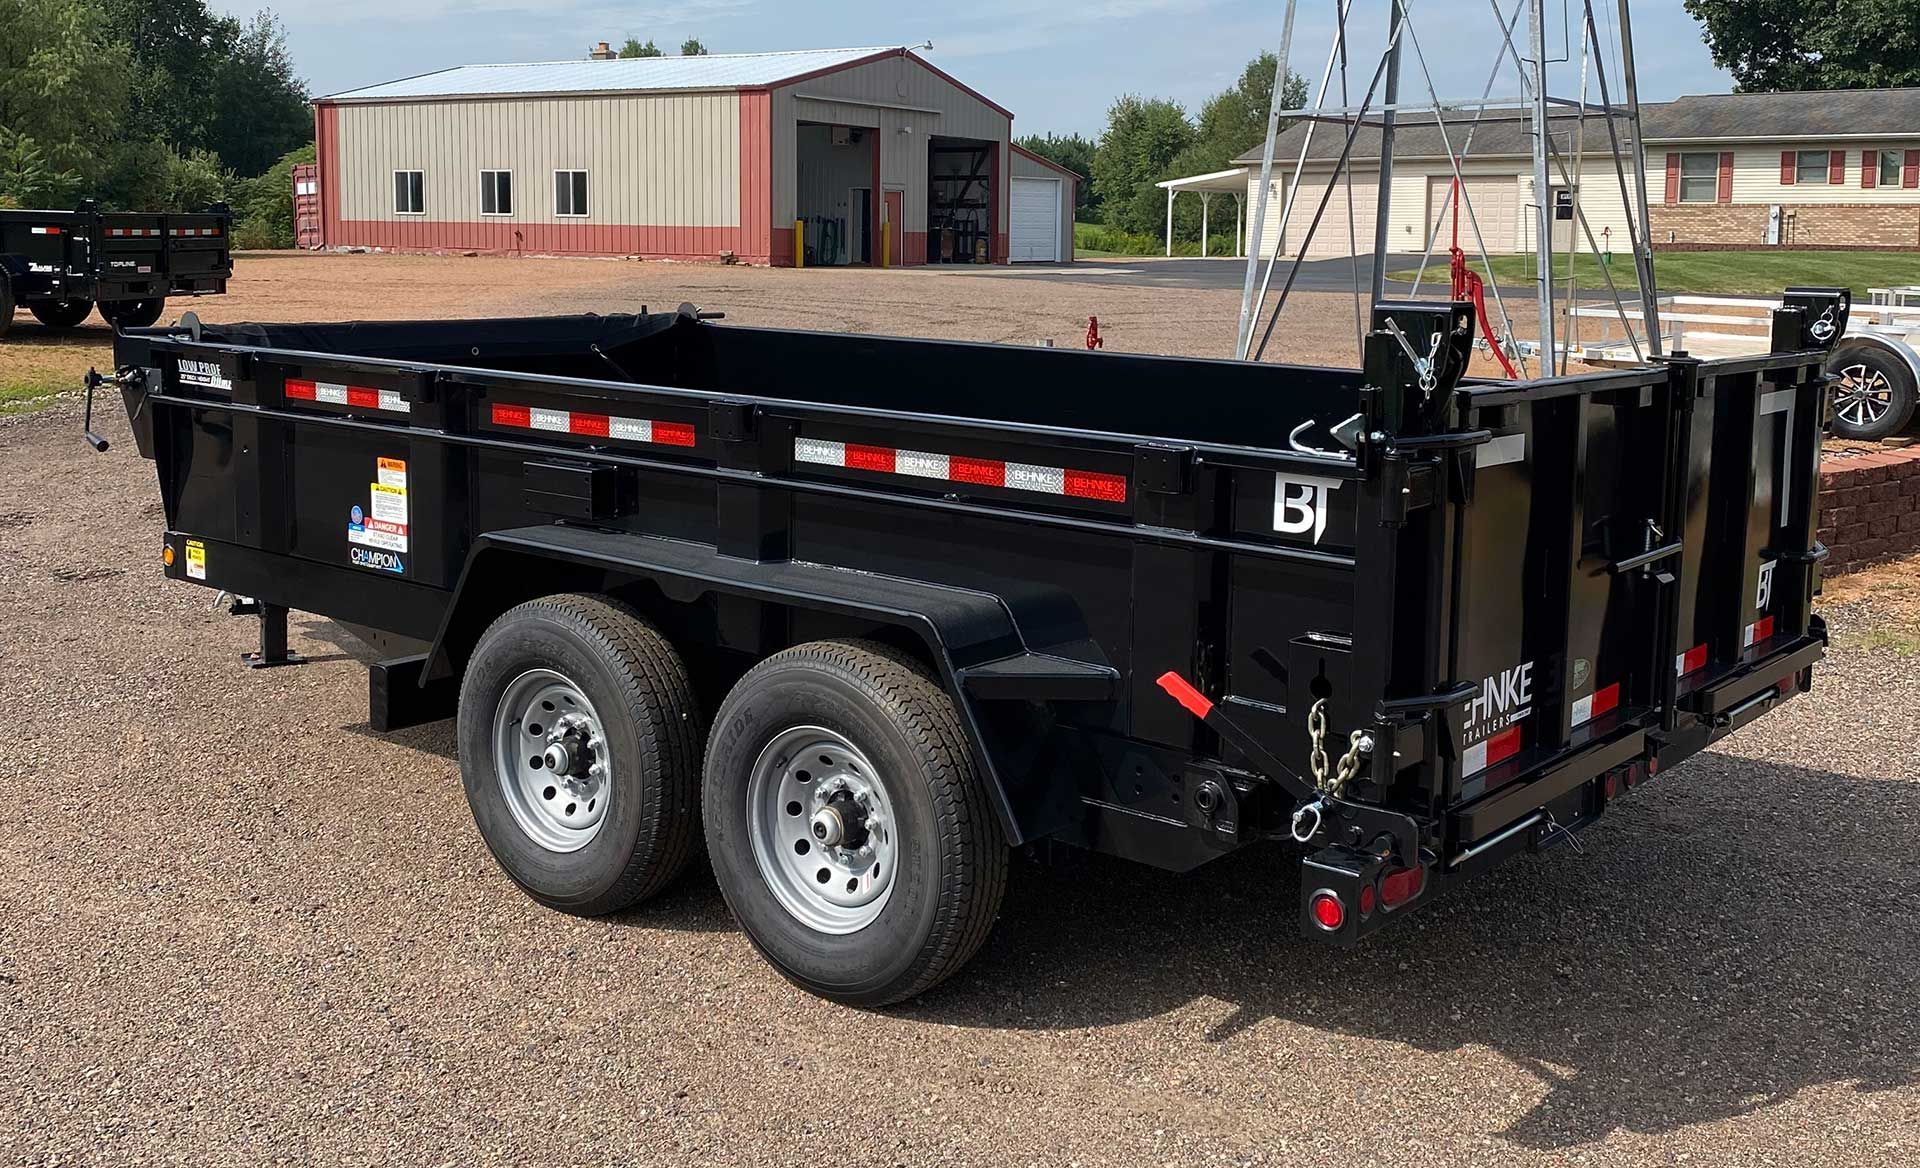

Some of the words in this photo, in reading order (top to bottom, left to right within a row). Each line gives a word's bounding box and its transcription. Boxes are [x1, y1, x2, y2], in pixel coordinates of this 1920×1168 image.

[177, 358, 198, 371] LOW
[198, 361, 222, 376] PROF
[536, 413, 562, 425] BEHNKE
[615, 422, 644, 434] BEHNKE
[802, 443, 836, 458] BEHNKE
[852, 450, 887, 464] BEHNKE
[904, 456, 939, 471] BEHNKE
[958, 462, 995, 477] BEHNKE
[1014, 469, 1053, 484] BEHNKE
[1073, 476, 1114, 492] BEHNKE
[1273, 471, 1343, 546] BT
[373, 521, 398, 533] DANGER
[351, 547, 397, 568] CHAMPION
[1755, 559, 1778, 612] BT
